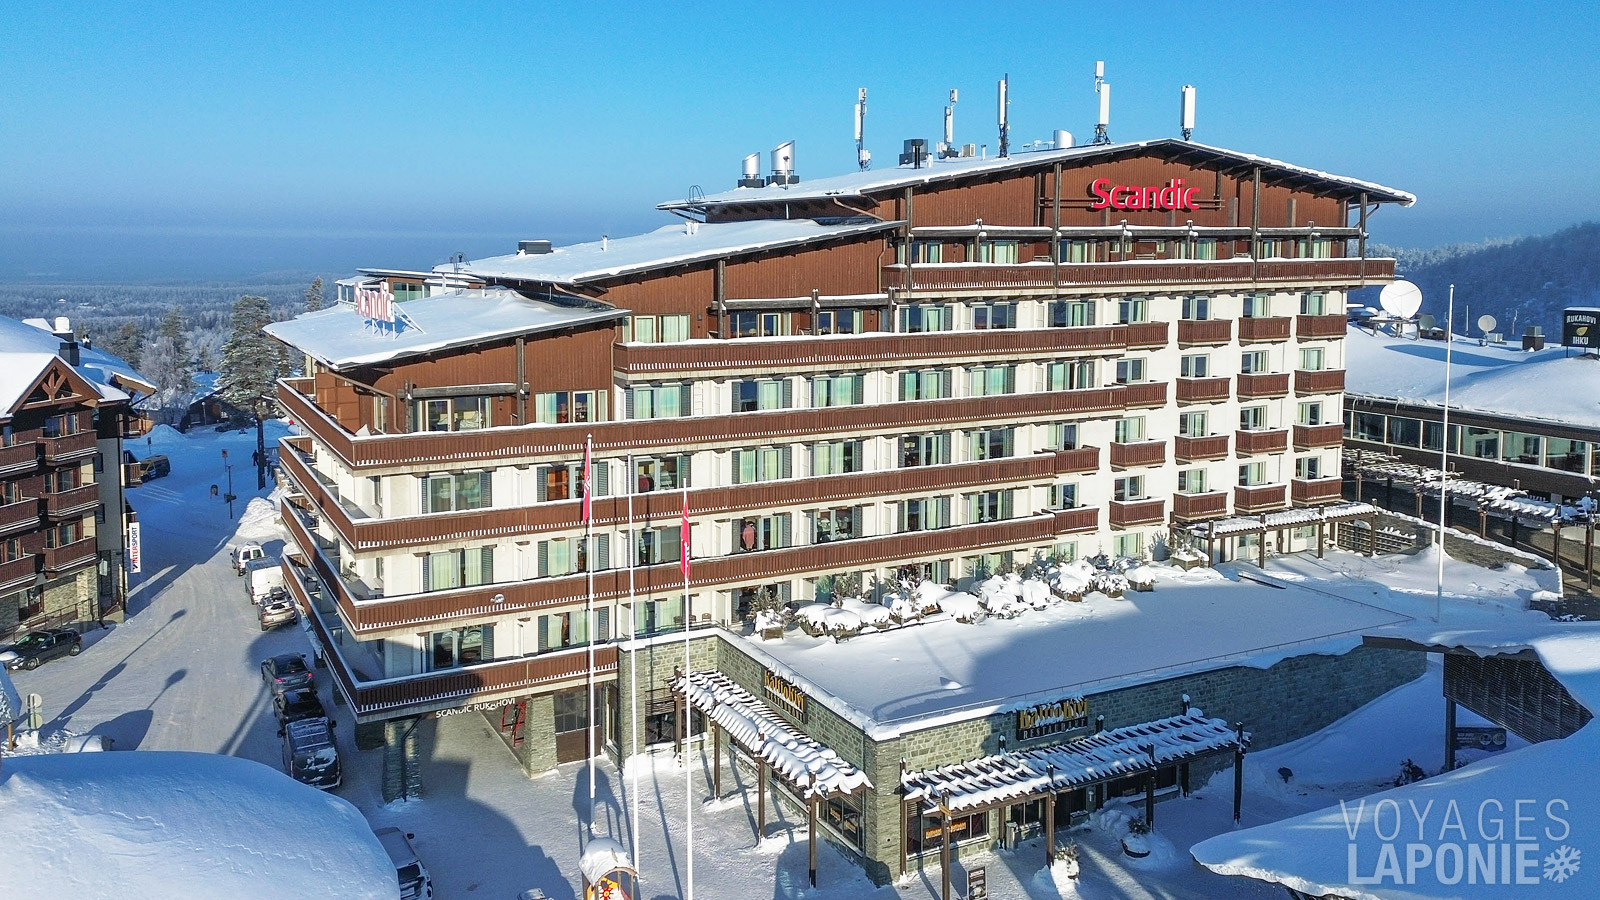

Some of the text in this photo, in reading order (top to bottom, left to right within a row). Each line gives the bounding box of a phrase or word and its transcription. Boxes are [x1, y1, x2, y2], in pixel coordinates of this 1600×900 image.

[1092, 178, 1200, 210] Scandic
[354, 281, 394, 322] Scandic
[1566, 315, 1597, 324] RUKAHOVI
[1573, 336, 1589, 344] IHKU
[131, 526, 139, 564] INTERSPORT
